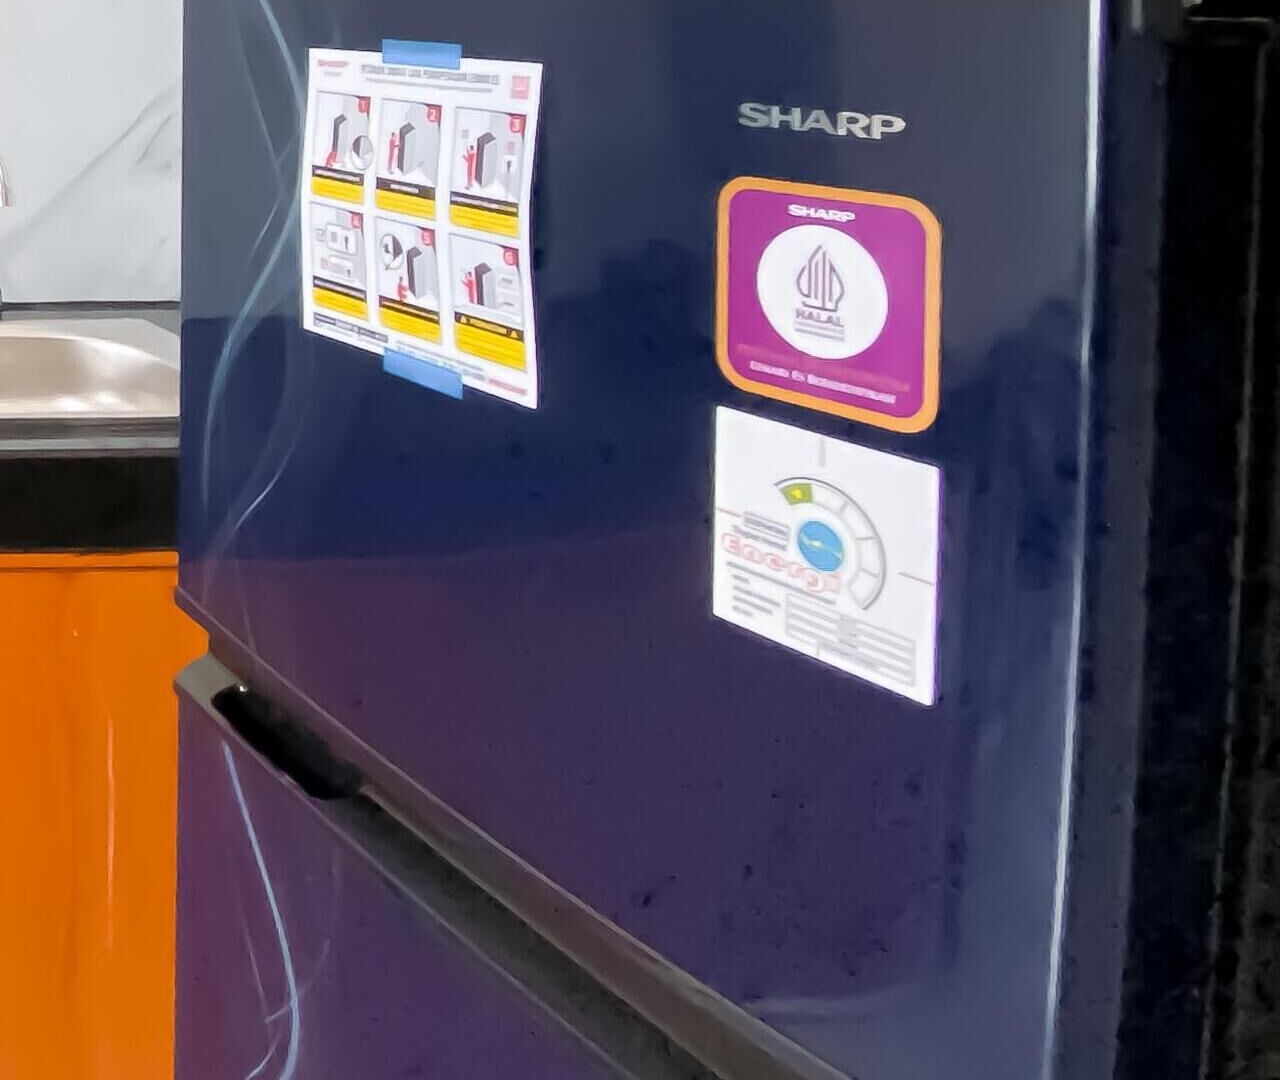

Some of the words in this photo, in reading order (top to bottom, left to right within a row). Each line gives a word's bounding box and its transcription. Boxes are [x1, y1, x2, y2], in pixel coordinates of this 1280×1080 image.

[737, 101, 907, 140] SHARP
[787, 204, 856, 222] SHARP
[795, 309, 845, 328] HALAL
